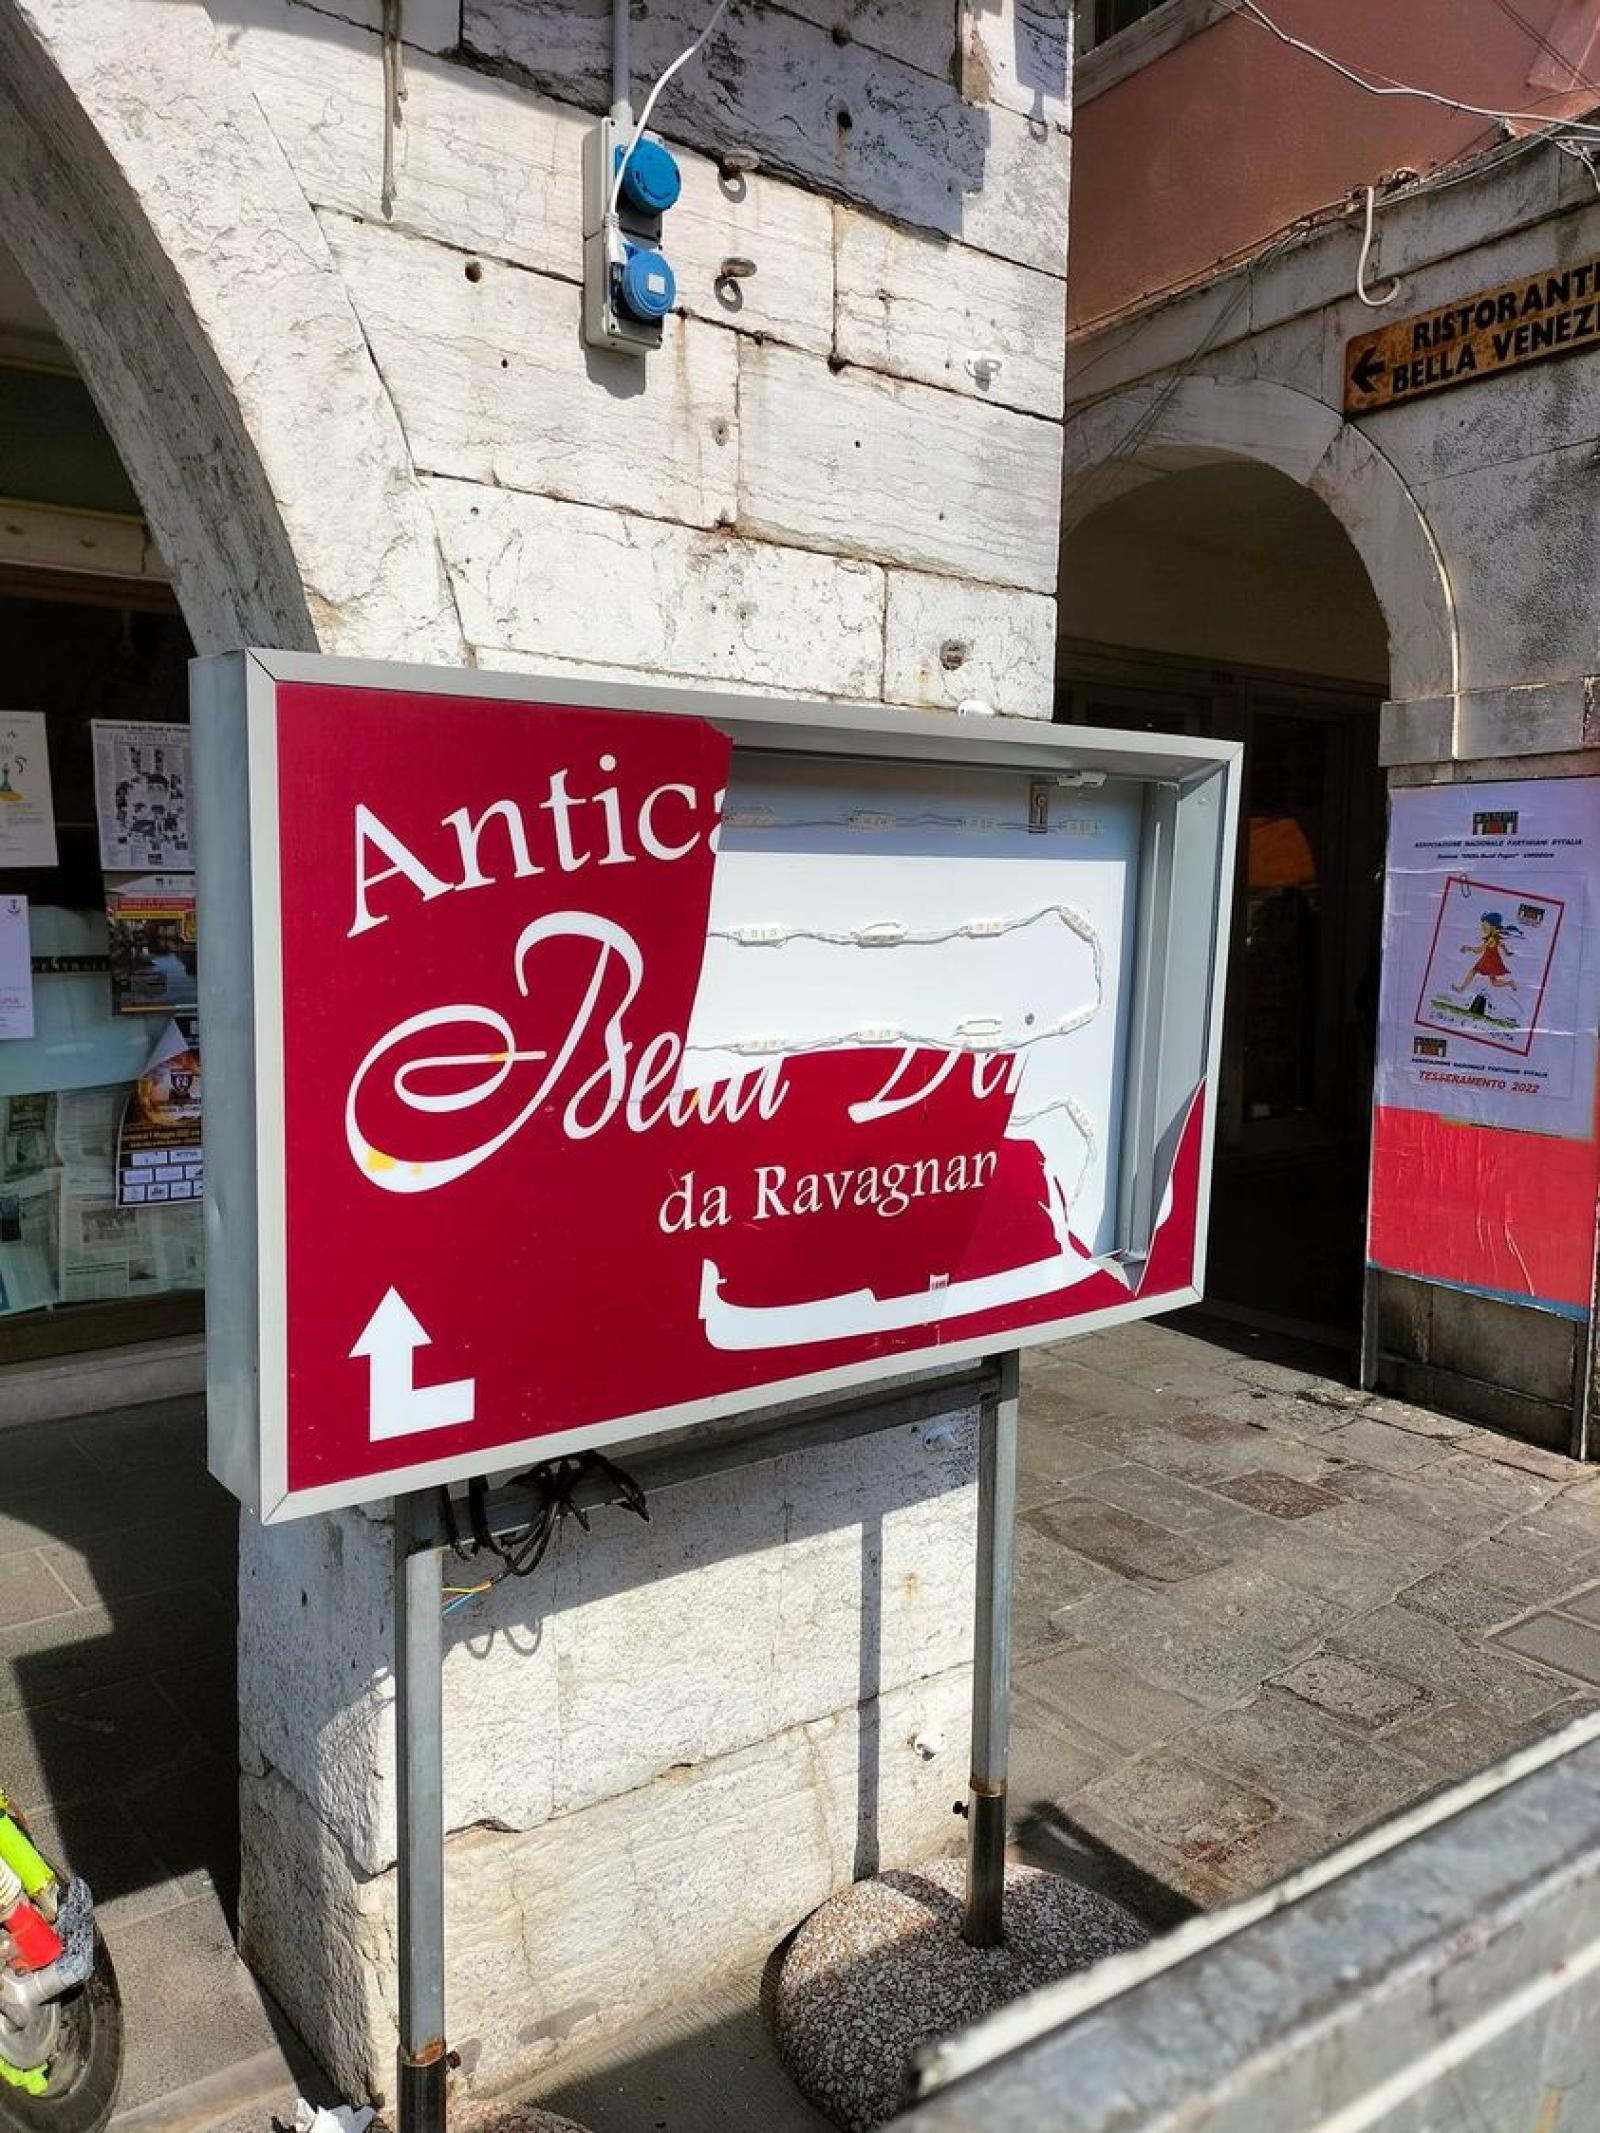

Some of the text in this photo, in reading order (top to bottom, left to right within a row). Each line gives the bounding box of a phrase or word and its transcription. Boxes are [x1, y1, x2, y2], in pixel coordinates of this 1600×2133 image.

[1393, 343, 1477, 393] BELLA
[1419, 1070, 1540, 1094] TESSERAMENTO 2022
[659, 1171, 731, 1234] da
